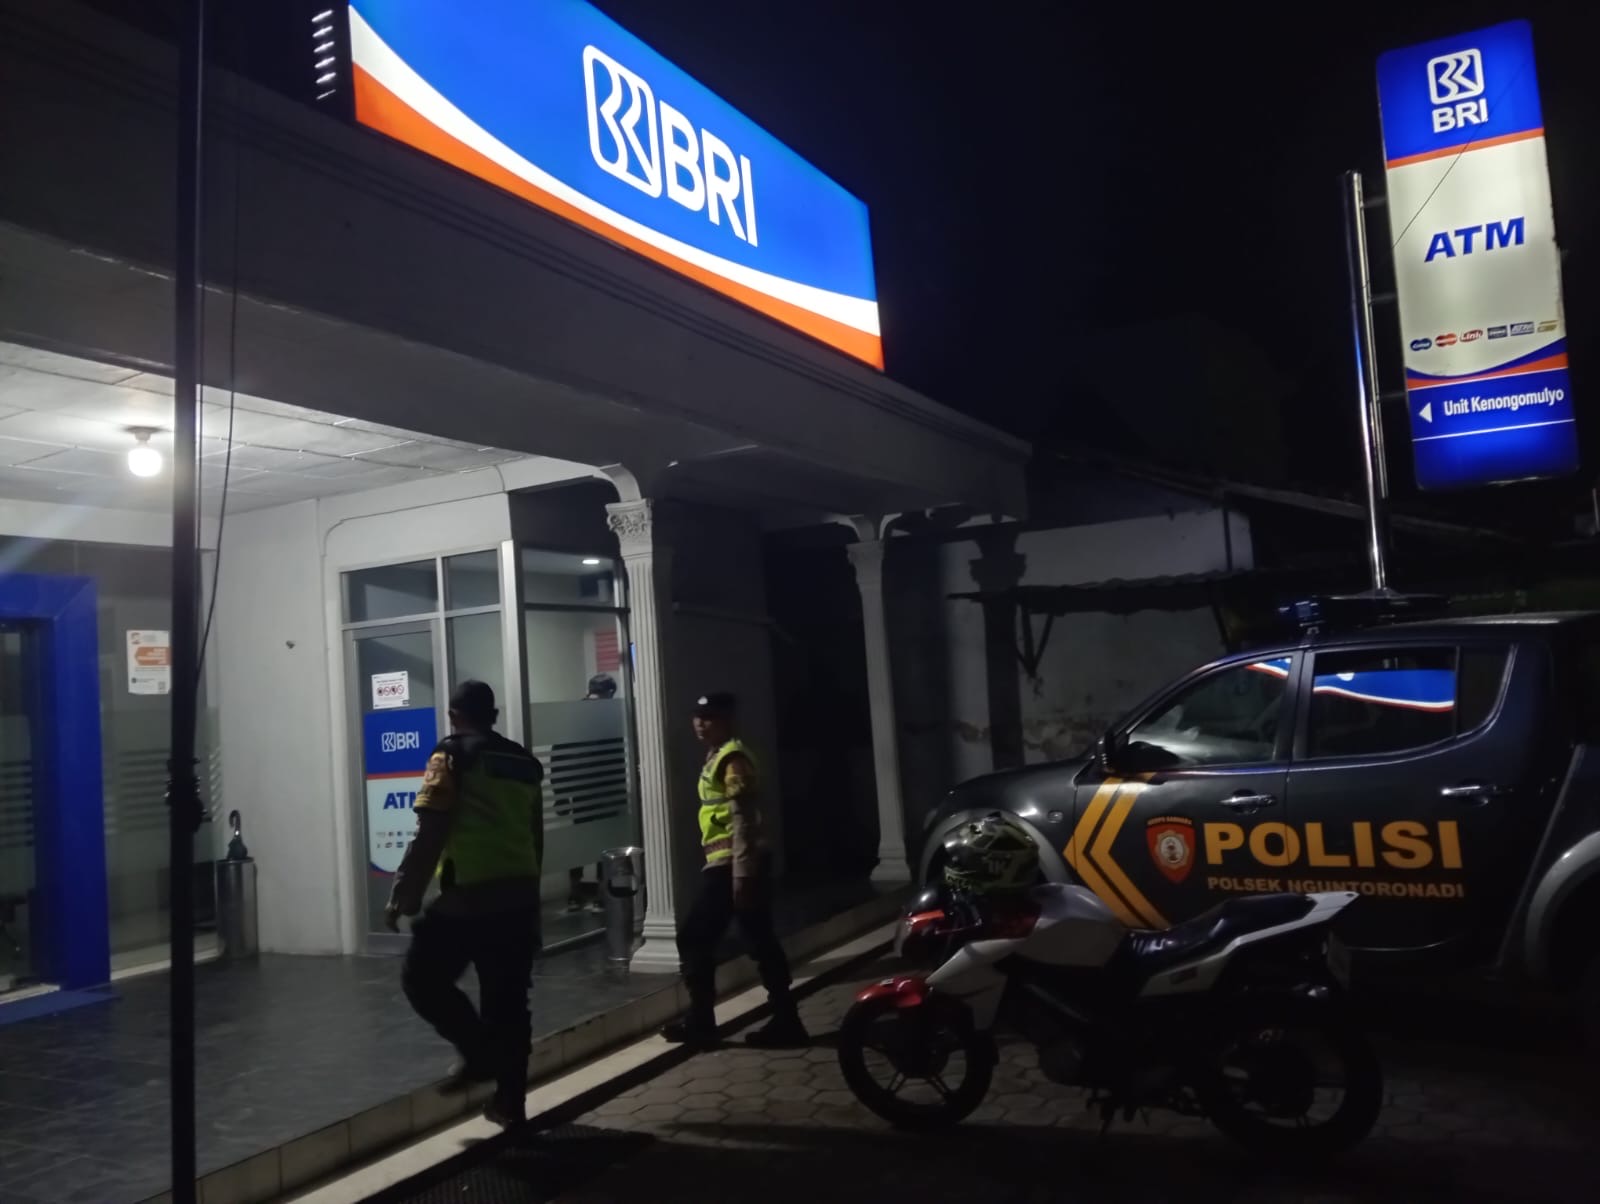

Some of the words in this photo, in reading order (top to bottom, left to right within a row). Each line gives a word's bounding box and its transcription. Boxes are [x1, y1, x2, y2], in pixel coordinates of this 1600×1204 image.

[1432, 98, 1488, 133] BRI
[659, 99, 758, 248] BRI
[1424, 216, 1525, 263] ATM
[1444, 398, 1469, 416] Unit
[1471, 387, 1564, 412] Kenongomulyo
[396, 731, 420, 750] BRI
[1203, 820, 1463, 869] POLISI
[1207, 876, 1283, 892] POLSEK
[1287, 879, 1465, 899] NGUNTORONADI
